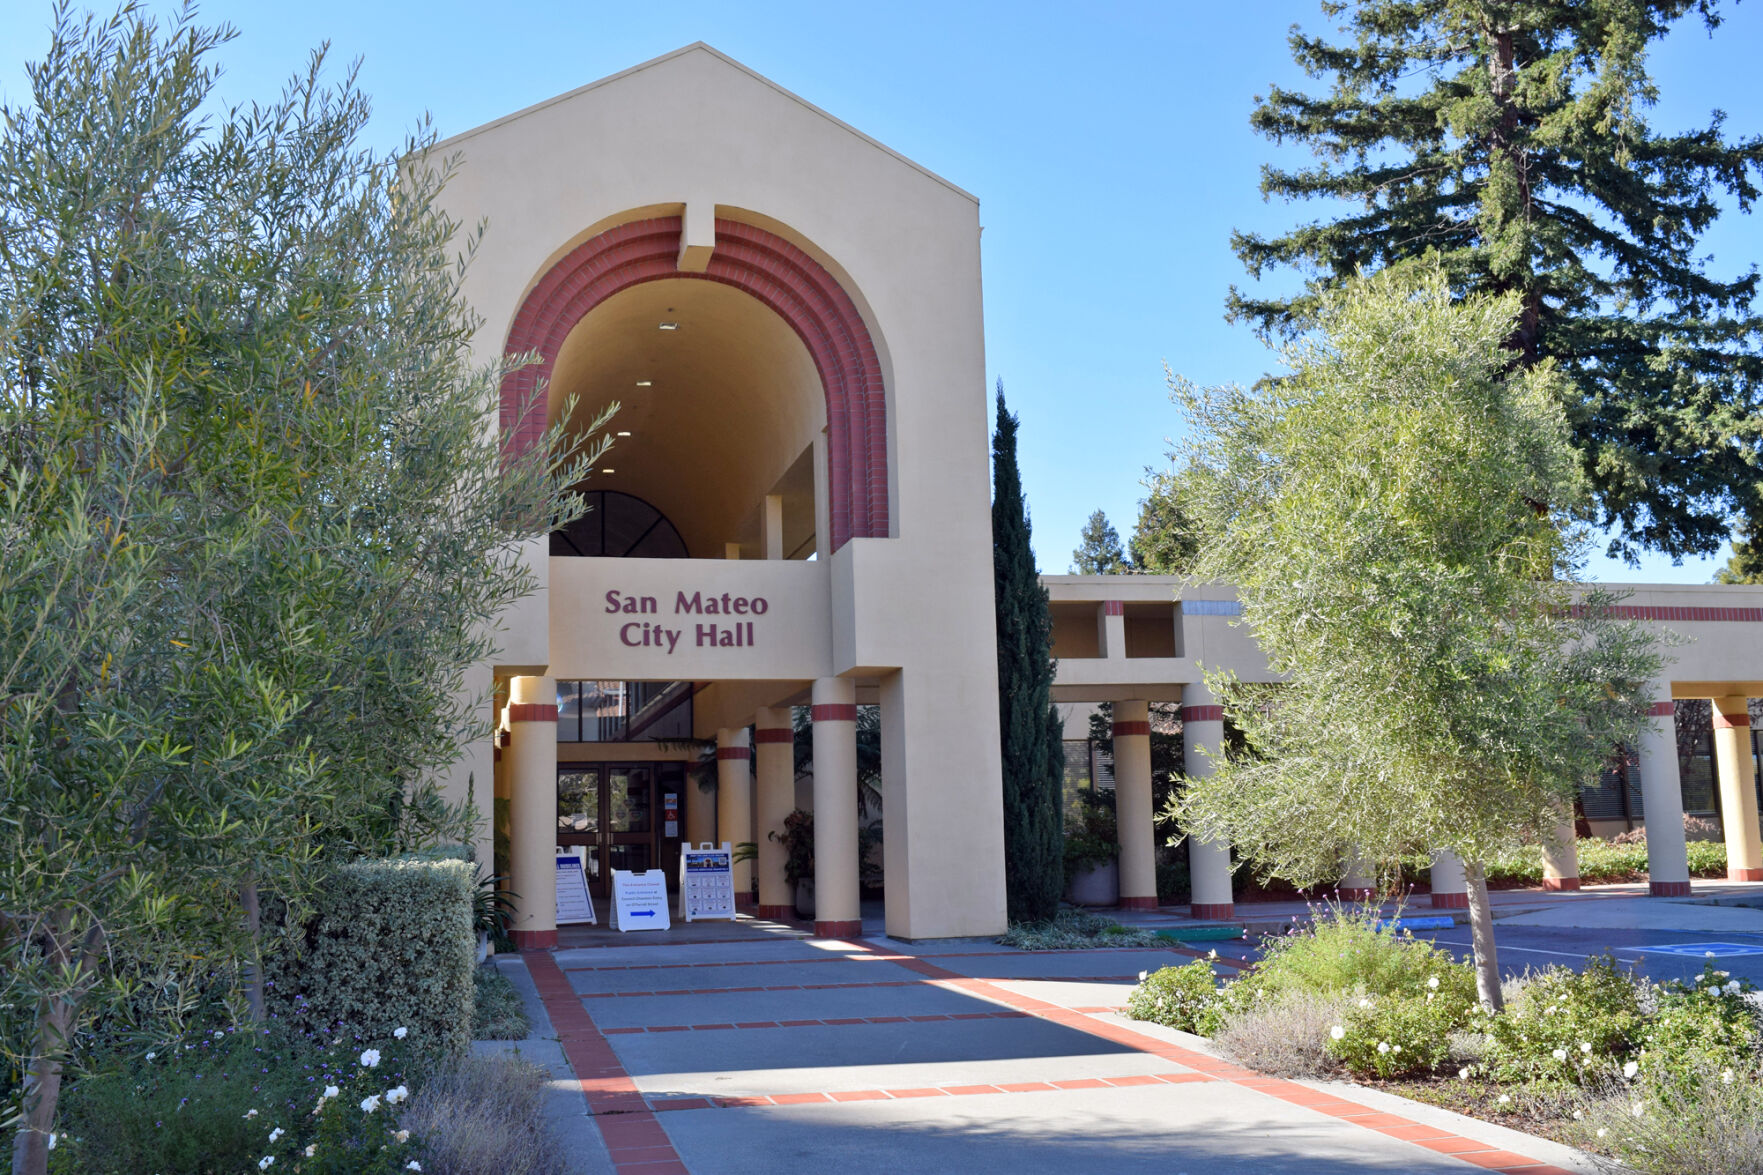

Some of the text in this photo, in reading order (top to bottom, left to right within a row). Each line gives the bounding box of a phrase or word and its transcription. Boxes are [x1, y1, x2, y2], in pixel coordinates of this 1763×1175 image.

[605, 590, 768, 615] San Mateo
[620, 622, 754, 654] City Hall
